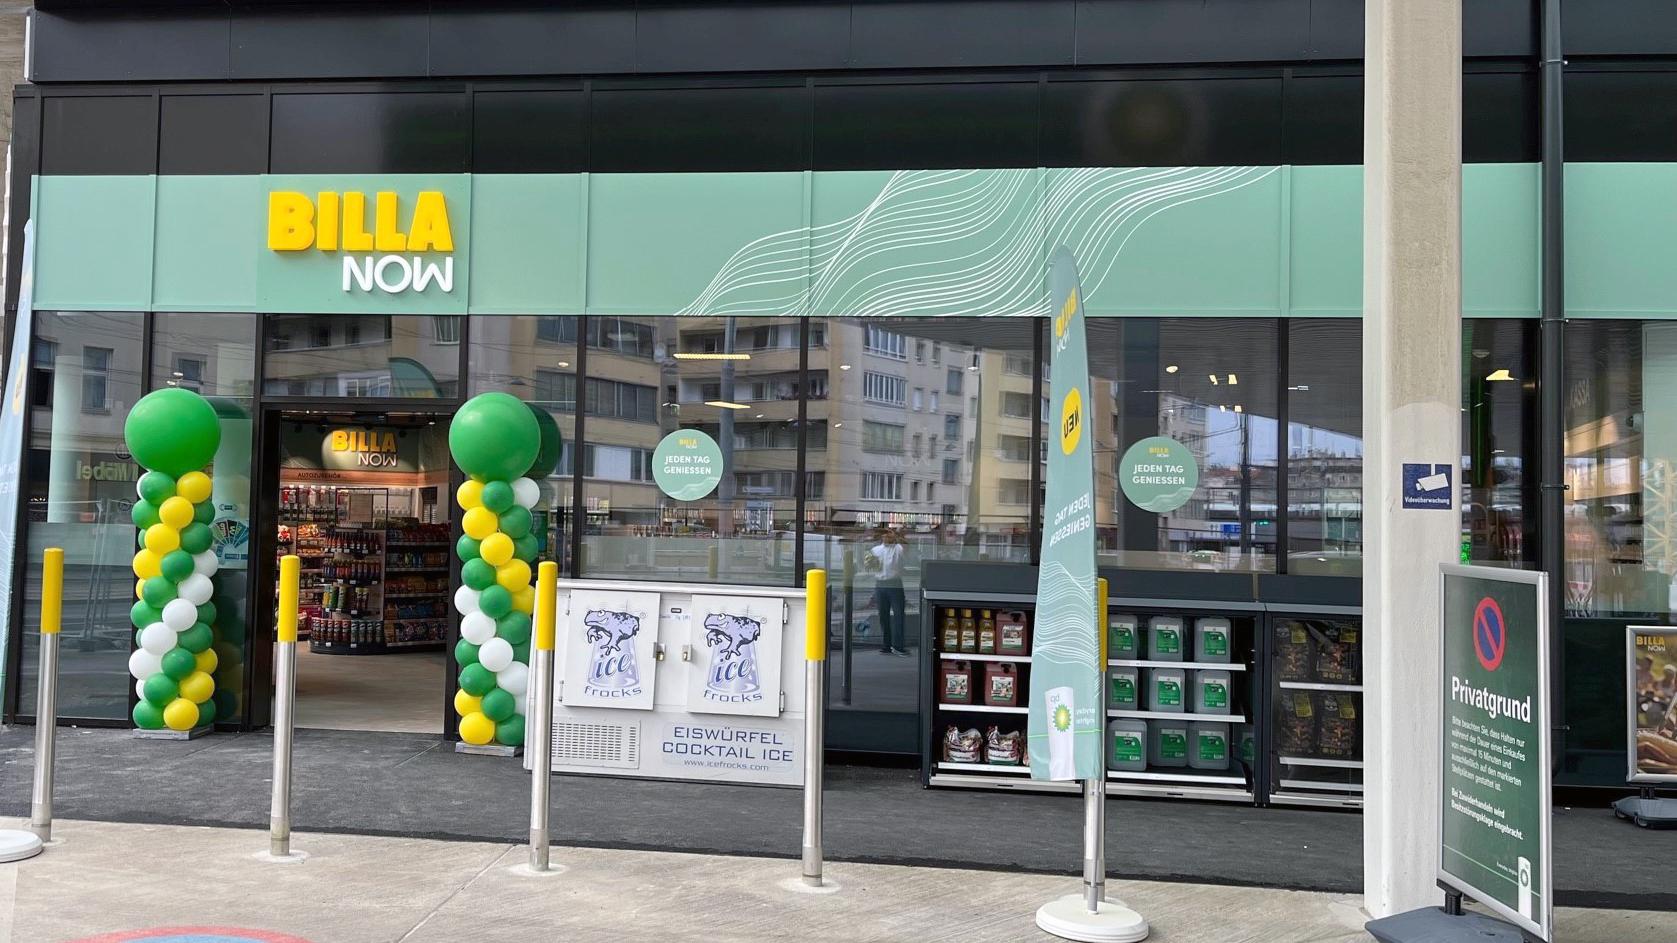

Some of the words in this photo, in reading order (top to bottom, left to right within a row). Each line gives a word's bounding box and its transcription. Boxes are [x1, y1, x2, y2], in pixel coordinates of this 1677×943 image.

[268, 191, 453, 251] BILLA
[342, 254, 453, 293] NOW
[331, 430, 397, 452] BILLA
[357, 453, 397, 467] NOW
[664, 455, 691, 465] JEDEN
[693, 455, 710, 464] TAG
[663, 466, 712, 475] GENIESSEN
[1133, 464, 1162, 474] JEDEN
[1165, 464, 1184, 473] TAG
[1132, 475, 1185, 485] GENIESSEN
[1635, 635, 1665, 646] BILLA
[595, 653, 631, 679] ice
[715, 658, 752, 683] ice
[1452, 676, 1531, 723] Privatgrund
[674, 726, 783, 745] EISWÜRFEL
[1501, 732, 1515, 744] Halten
[662, 741, 755, 759] COCKTAIL
[763, 749, 793, 762] ICE
[684, 759, 769, 771] www.icefrocks.com
